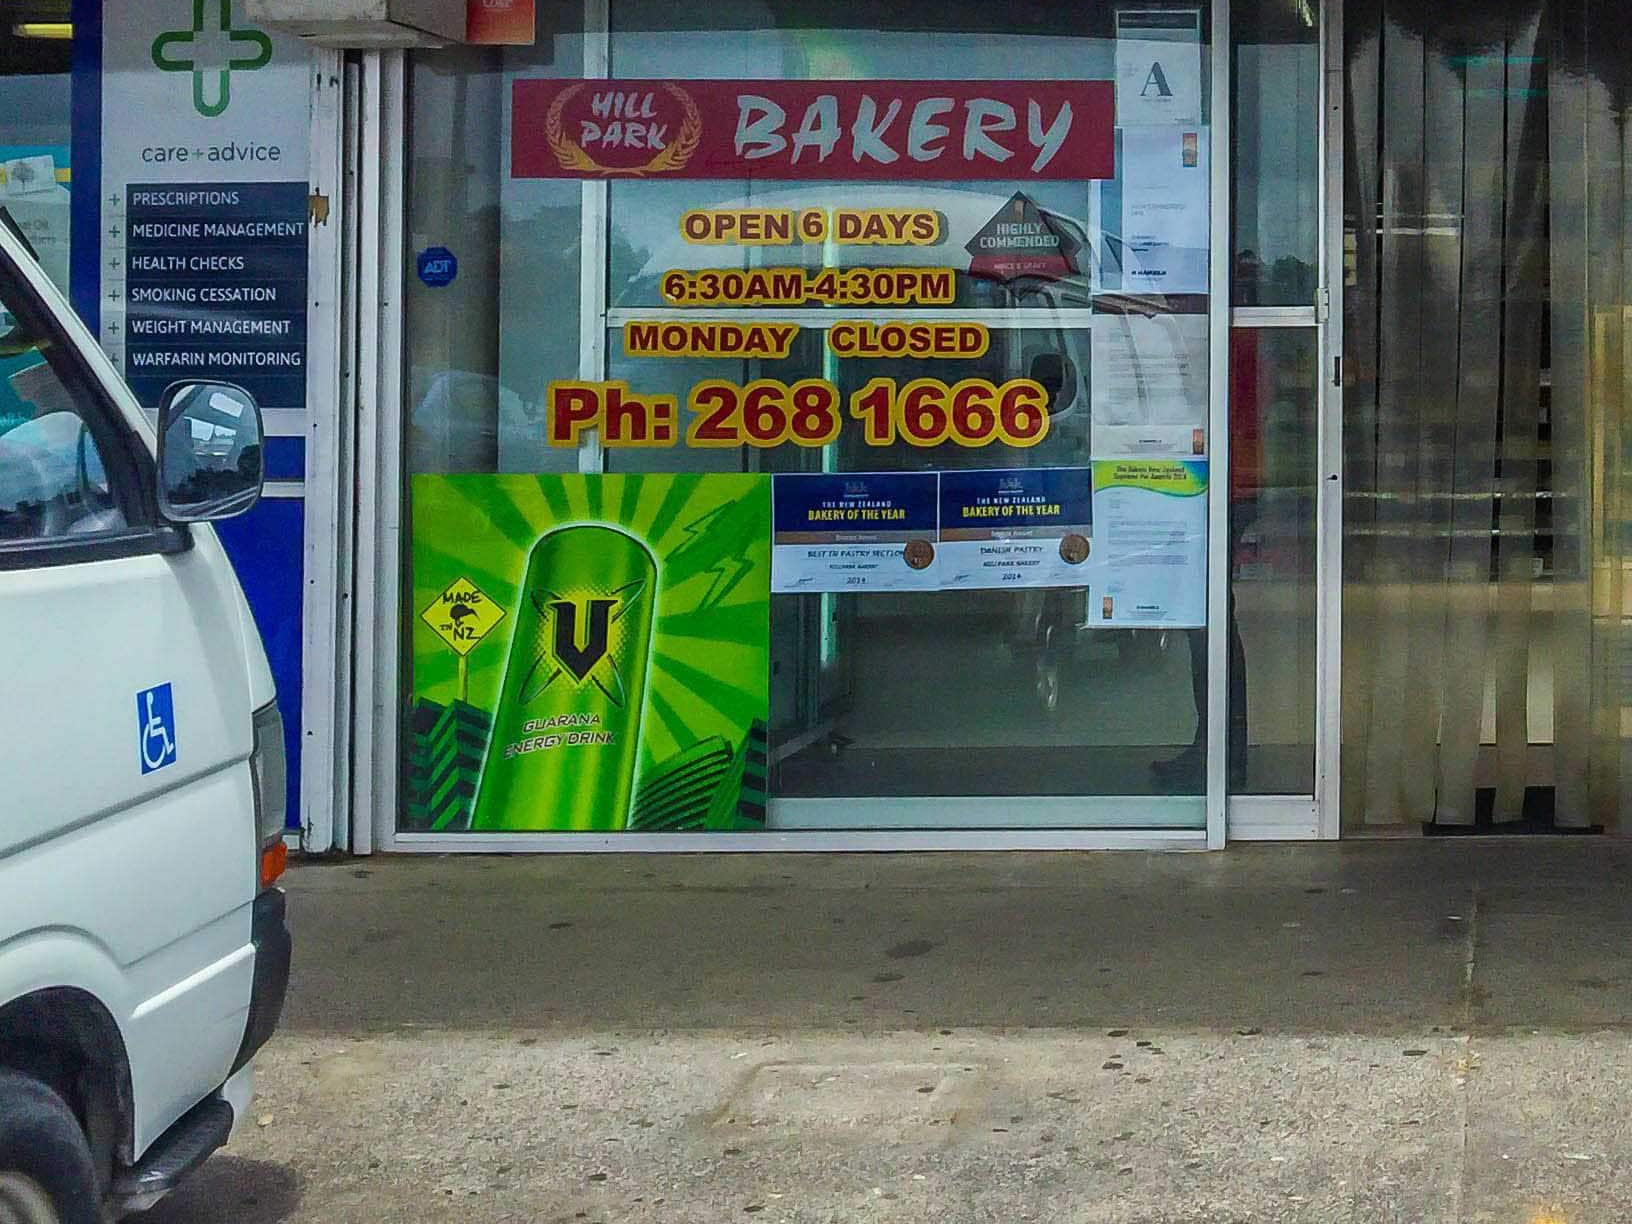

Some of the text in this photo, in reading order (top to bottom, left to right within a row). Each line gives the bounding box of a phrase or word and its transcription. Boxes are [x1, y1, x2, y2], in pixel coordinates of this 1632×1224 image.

[1140, 62, 1173, 96] A
[592, 91, 657, 120] HILL
[580, 120, 669, 151] PARK
[734, 93, 1074, 171] BAKERY
[207, 142, 282, 162] advice
[133, 191, 240, 207] PRESCRIPTIONS
[132, 221, 305, 238] MEDICINE MANAGEMENT
[684, 211, 937, 242] OPEN 6 DAYS
[996, 223, 1042, 235] HIGHLY
[980, 235, 1060, 249] COMMENDED
[132, 255, 245, 272] HEALTH CHECKS
[424, 259, 451, 274] ADT
[131, 287, 277, 303] SMOKING CESSATION
[664, 273, 951, 302] 6:30AM-4:30PM
[132, 319, 292, 335] WEIGHT MANAGEMENT
[629, 326, 985, 355] MONDAY CLOSED
[132, 351, 301, 367] WARFARIN MONITORING
[553, 385, 1044, 442] Ph: 268 1666
[808, 509, 906, 521] BAKERY OF THE YEAR
[962, 504, 1060, 518] BAKERY OF THE YEAR
[442, 590, 481, 605] MADE
[439, 623, 481, 642] IN NZ
[546, 598, 619, 686] V
[522, 713, 601, 734] GUARANA
[503, 731, 616, 760] ENERGY DRINK
